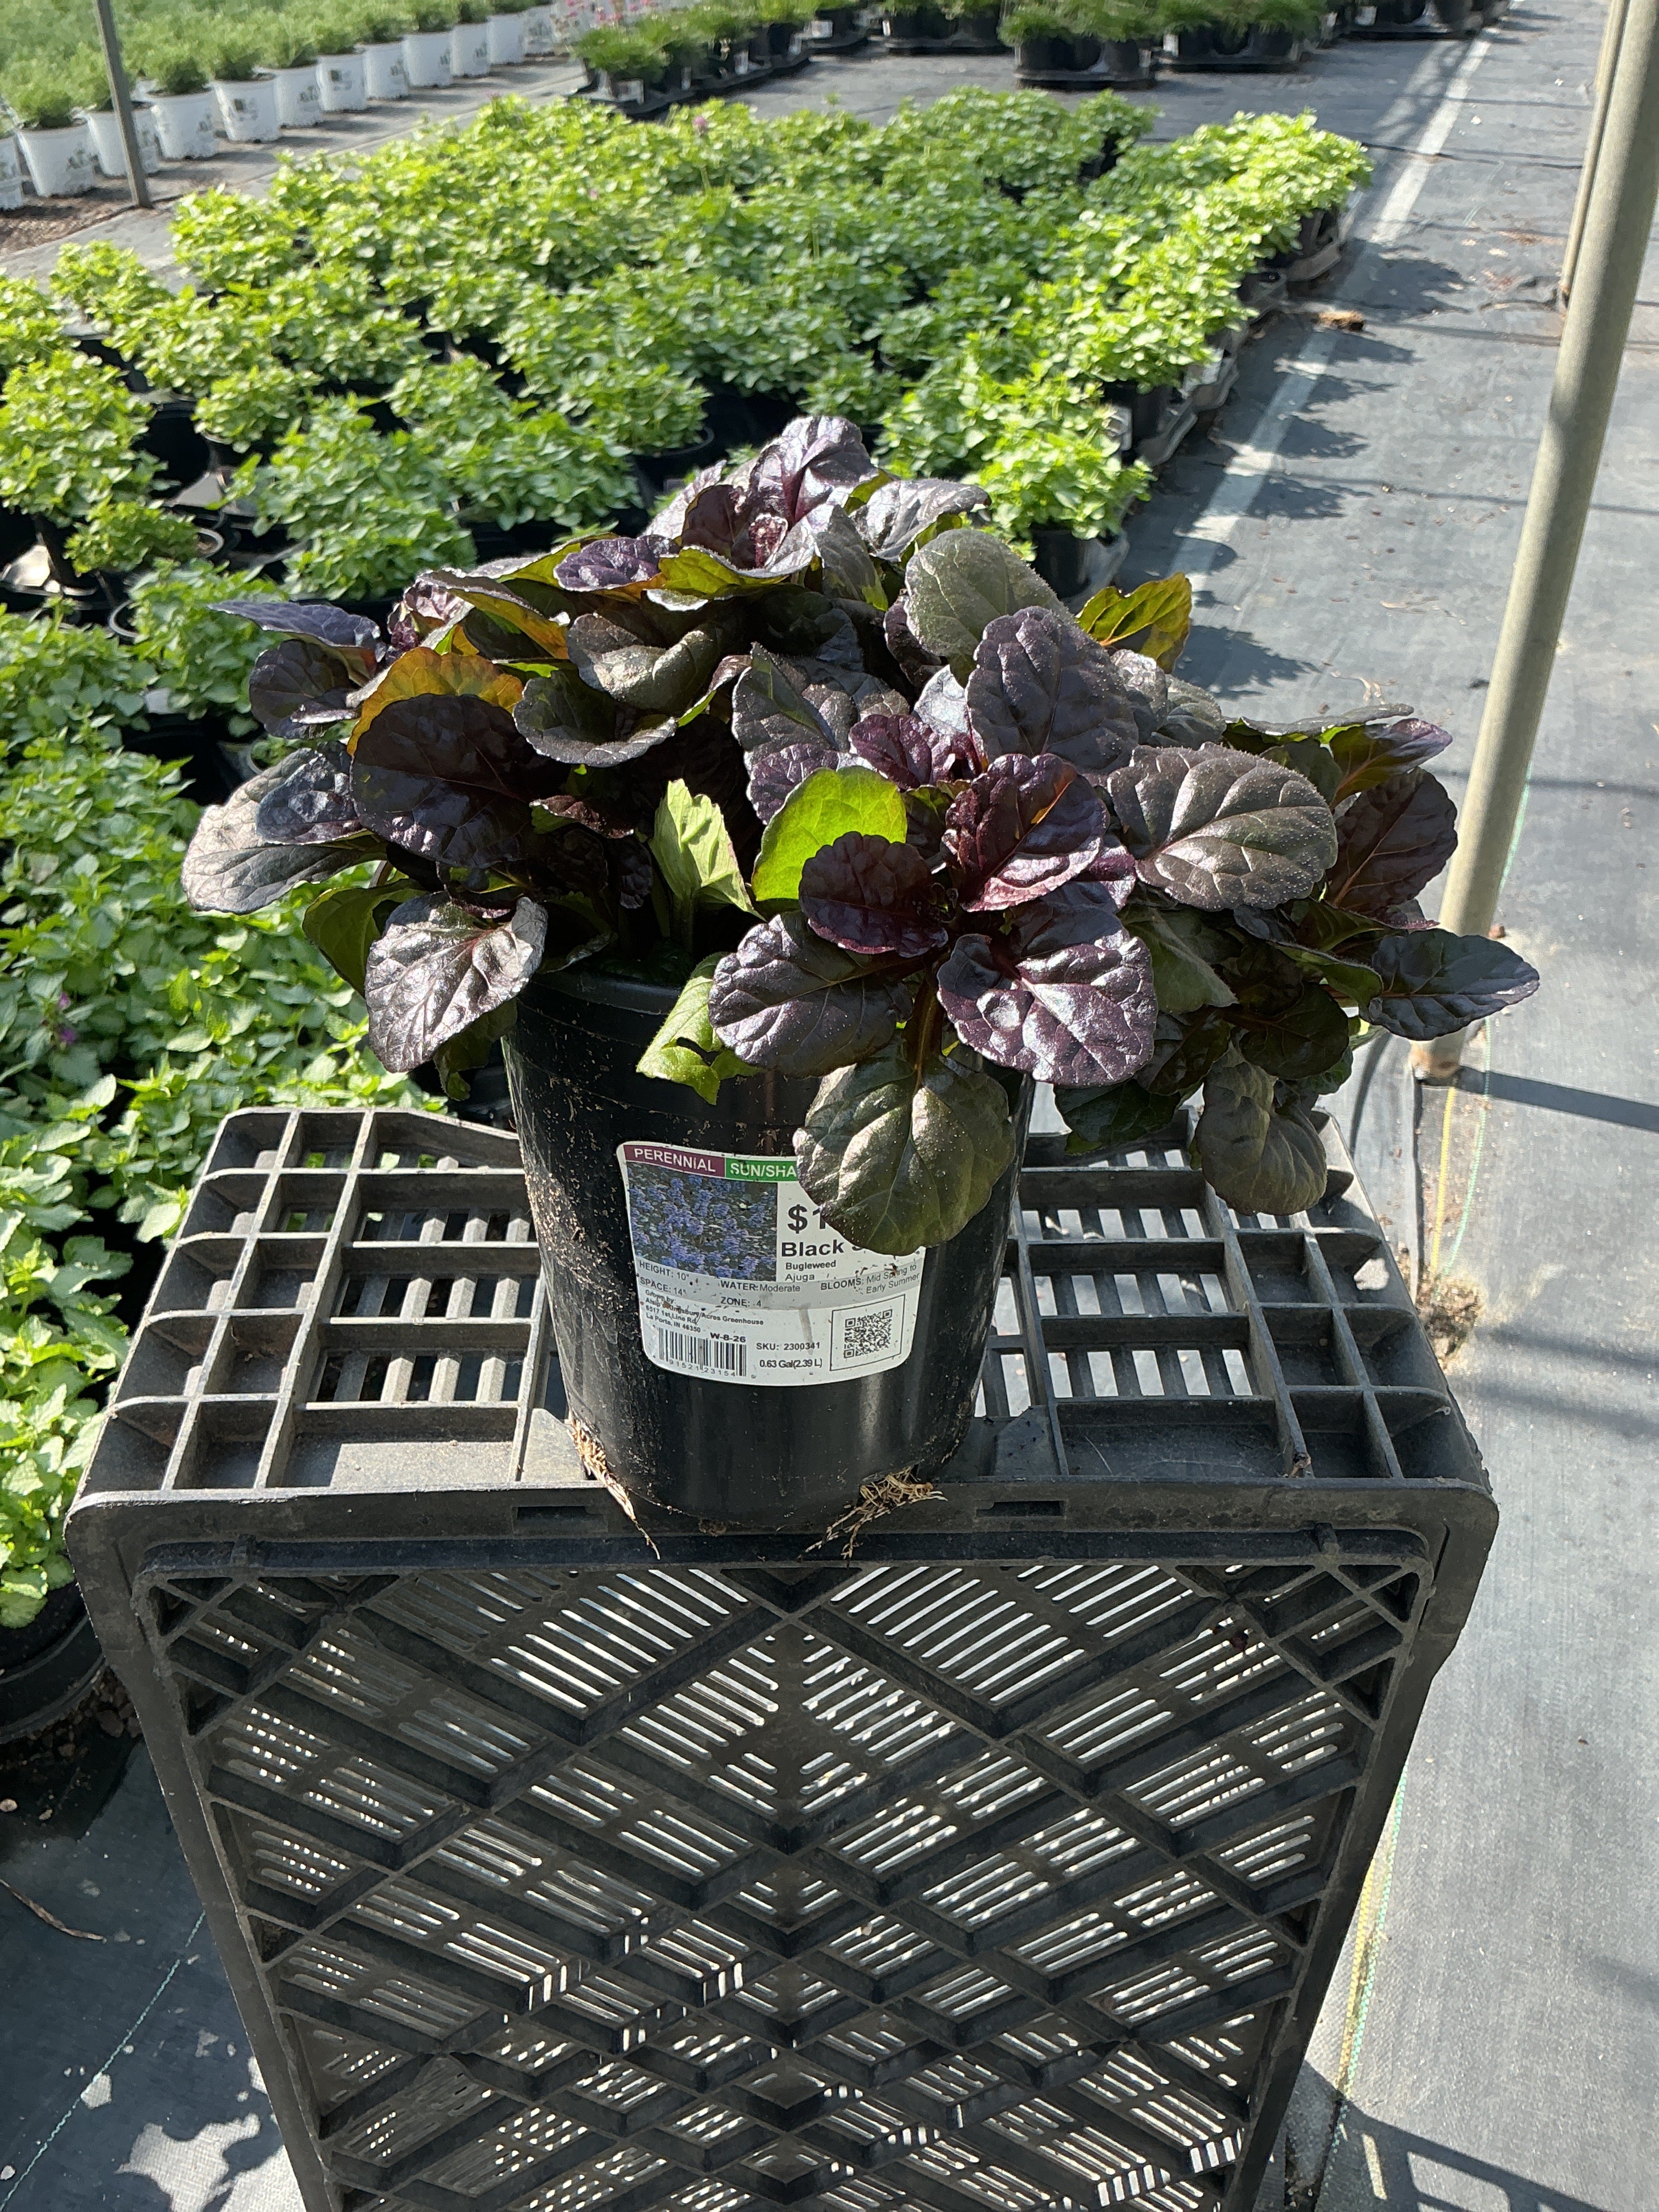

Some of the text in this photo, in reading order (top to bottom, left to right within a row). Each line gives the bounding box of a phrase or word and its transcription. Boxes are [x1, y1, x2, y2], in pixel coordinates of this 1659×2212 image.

[634, 1148, 716, 1172] PERENNIAL
[730, 1163, 797, 1177] SUN/SHA
[787, 1204, 826, 1234] $1
[781, 1239, 844, 1257] Black
[639, 1260, 689, 1281] HEIGHT: 10"
[786, 1260, 836, 1271] Bugleweed
[785, 1273, 815, 1283] Ajuga
[820, 1263, 917, 1290] BLOOMS: Mid Spng to
[866, 1272, 920, 1294] Early Summer
[640, 1277, 672, 1293] SPACE:
[720, 1280, 800, 1293] WATER: Moderate
[720, 1296, 751, 1307] ZONE:
[723, 1316, 764, 1325] Greenhouse
[710, 1332, 746, 1343] W-8-26
[756, 1341, 821, 1351] SKU: 2300341
[759, 1359, 777, 1368] 0.63
